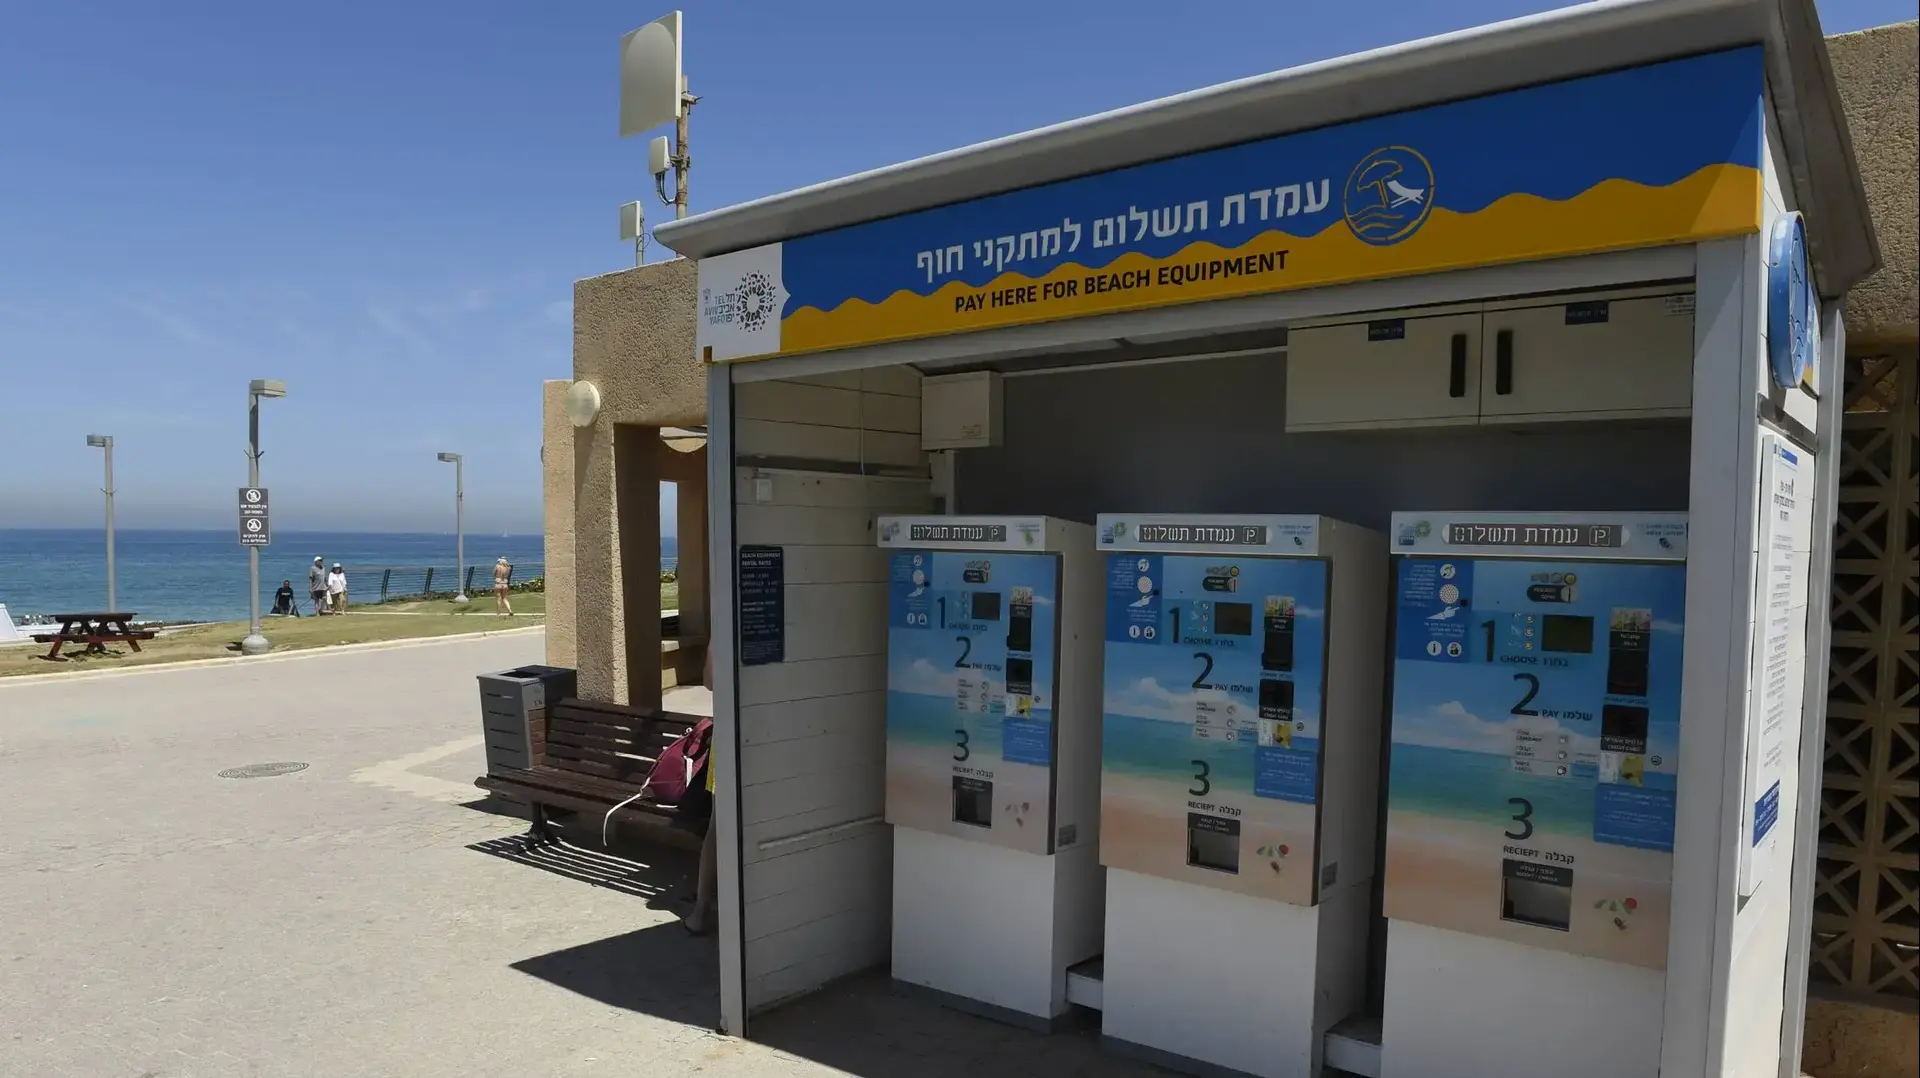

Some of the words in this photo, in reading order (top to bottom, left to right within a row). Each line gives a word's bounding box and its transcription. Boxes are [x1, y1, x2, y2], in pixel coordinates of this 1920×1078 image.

[1220, 178, 1329, 229] עמדת
[1093, 200, 1208, 249] תשלום
[973, 217, 1081, 272] למתקני
[917, 245, 963, 284] חוף
[955, 292, 987, 313] PAY
[991, 285, 1037, 308] HERE
[1043, 279, 1078, 301] FOR
[1084, 269, 1150, 294] BEACH
[1158, 250, 1289, 286] EQUIPMENT
[913, 525, 949, 539] תשלום
[952, 526, 983, 540] עמדת
[1142, 525, 1189, 541] תשלום
[1194, 527, 1235, 543] עמדת
[1454, 525, 1516, 542] תשלום
[1525, 527, 1578, 544] עמדת
[937, 597, 946, 629] 1
[1168, 607, 1180, 643] 1
[954, 636, 971, 668] 2
[1481, 621, 1495, 662] 1
[1192, 652, 1214, 689] 2
[1500, 654, 1539, 665] CHOOSE
[1215, 683, 1229, 691] PAY
[1510, 673, 1540, 716] 2
[1542, 709, 1560, 719] PAY
[1562, 709, 1594, 721] שלמו
[953, 729, 970, 762] 3
[1188, 760, 1211, 796] 3
[1219, 805, 1242, 817] קבלה
[1504, 798, 1533, 840] 3
[1503, 845, 1539, 857] RECIEPT
[1545, 851, 1575, 864] קבלה
